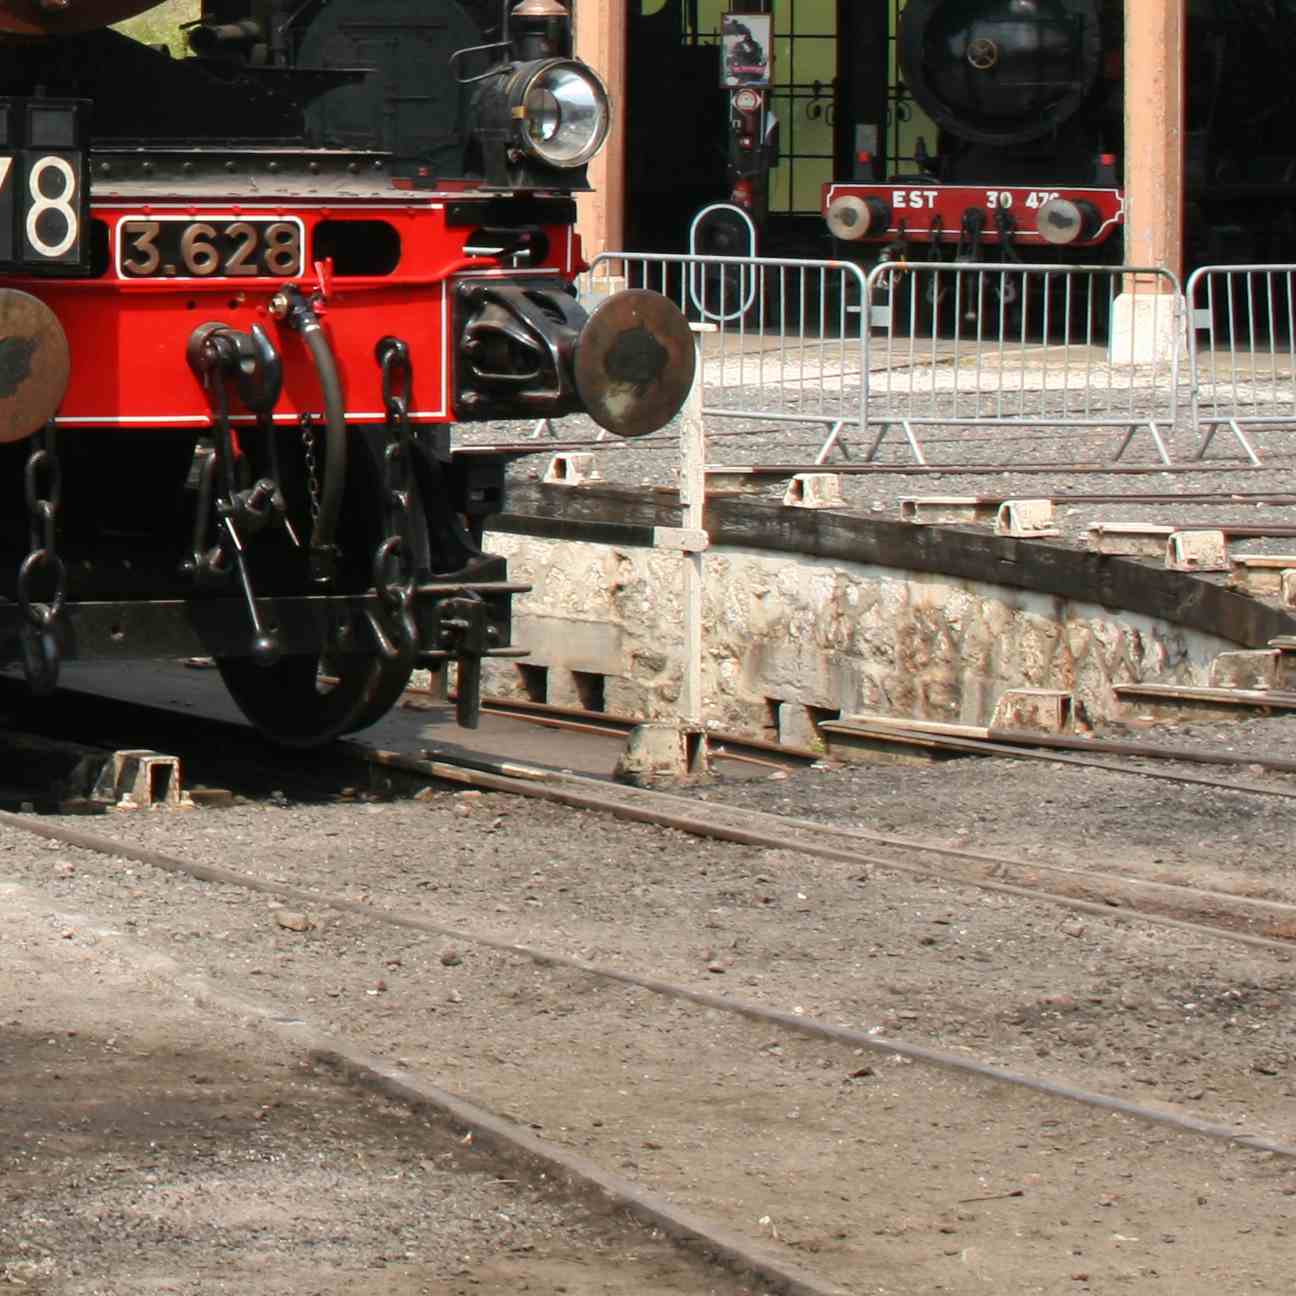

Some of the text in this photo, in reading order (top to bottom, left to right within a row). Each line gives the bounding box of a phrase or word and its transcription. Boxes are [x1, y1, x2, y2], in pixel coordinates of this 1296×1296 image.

[892, 190, 939, 209] EST
[985, 191, 1013, 209] 30
[124, 222, 300, 276] 3.628
